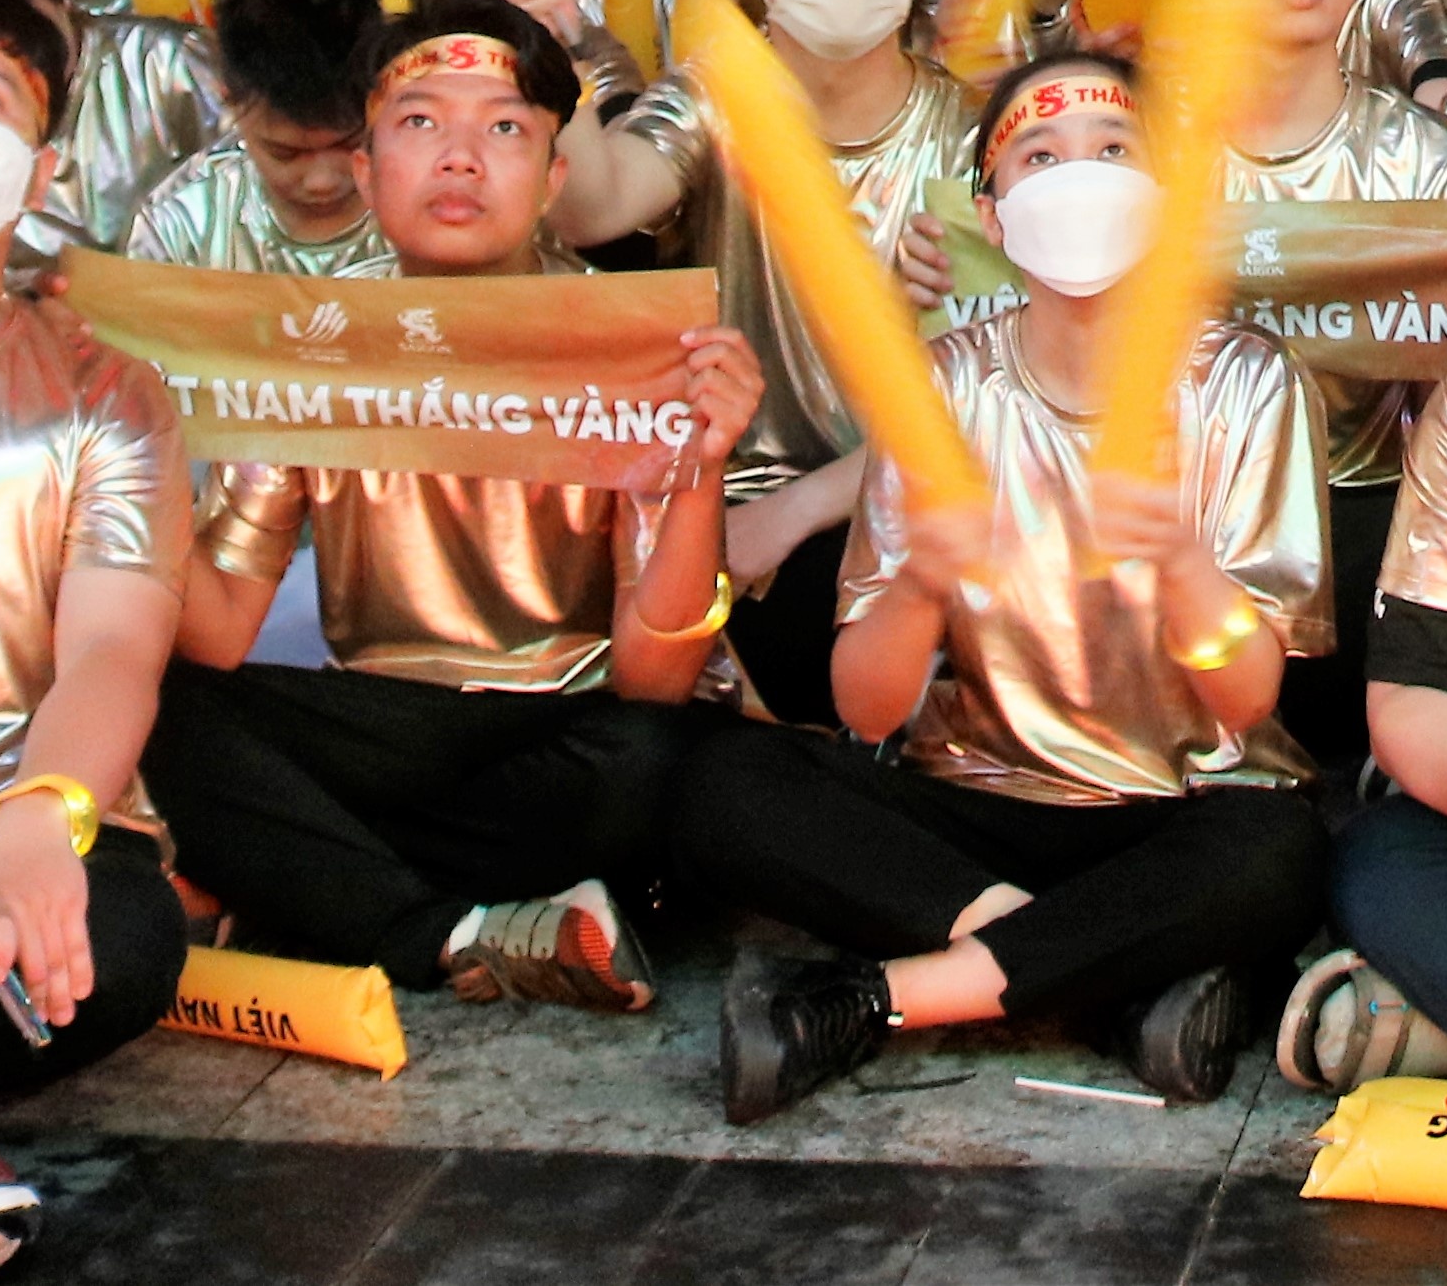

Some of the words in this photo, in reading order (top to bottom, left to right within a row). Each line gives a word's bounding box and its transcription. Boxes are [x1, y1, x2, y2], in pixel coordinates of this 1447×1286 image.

[212, 378, 333, 425] NAM
[342, 375, 533, 435] THẮNG
[542, 383, 695, 446] VÀNG
[233, 997, 300, 1042] VIỆT
